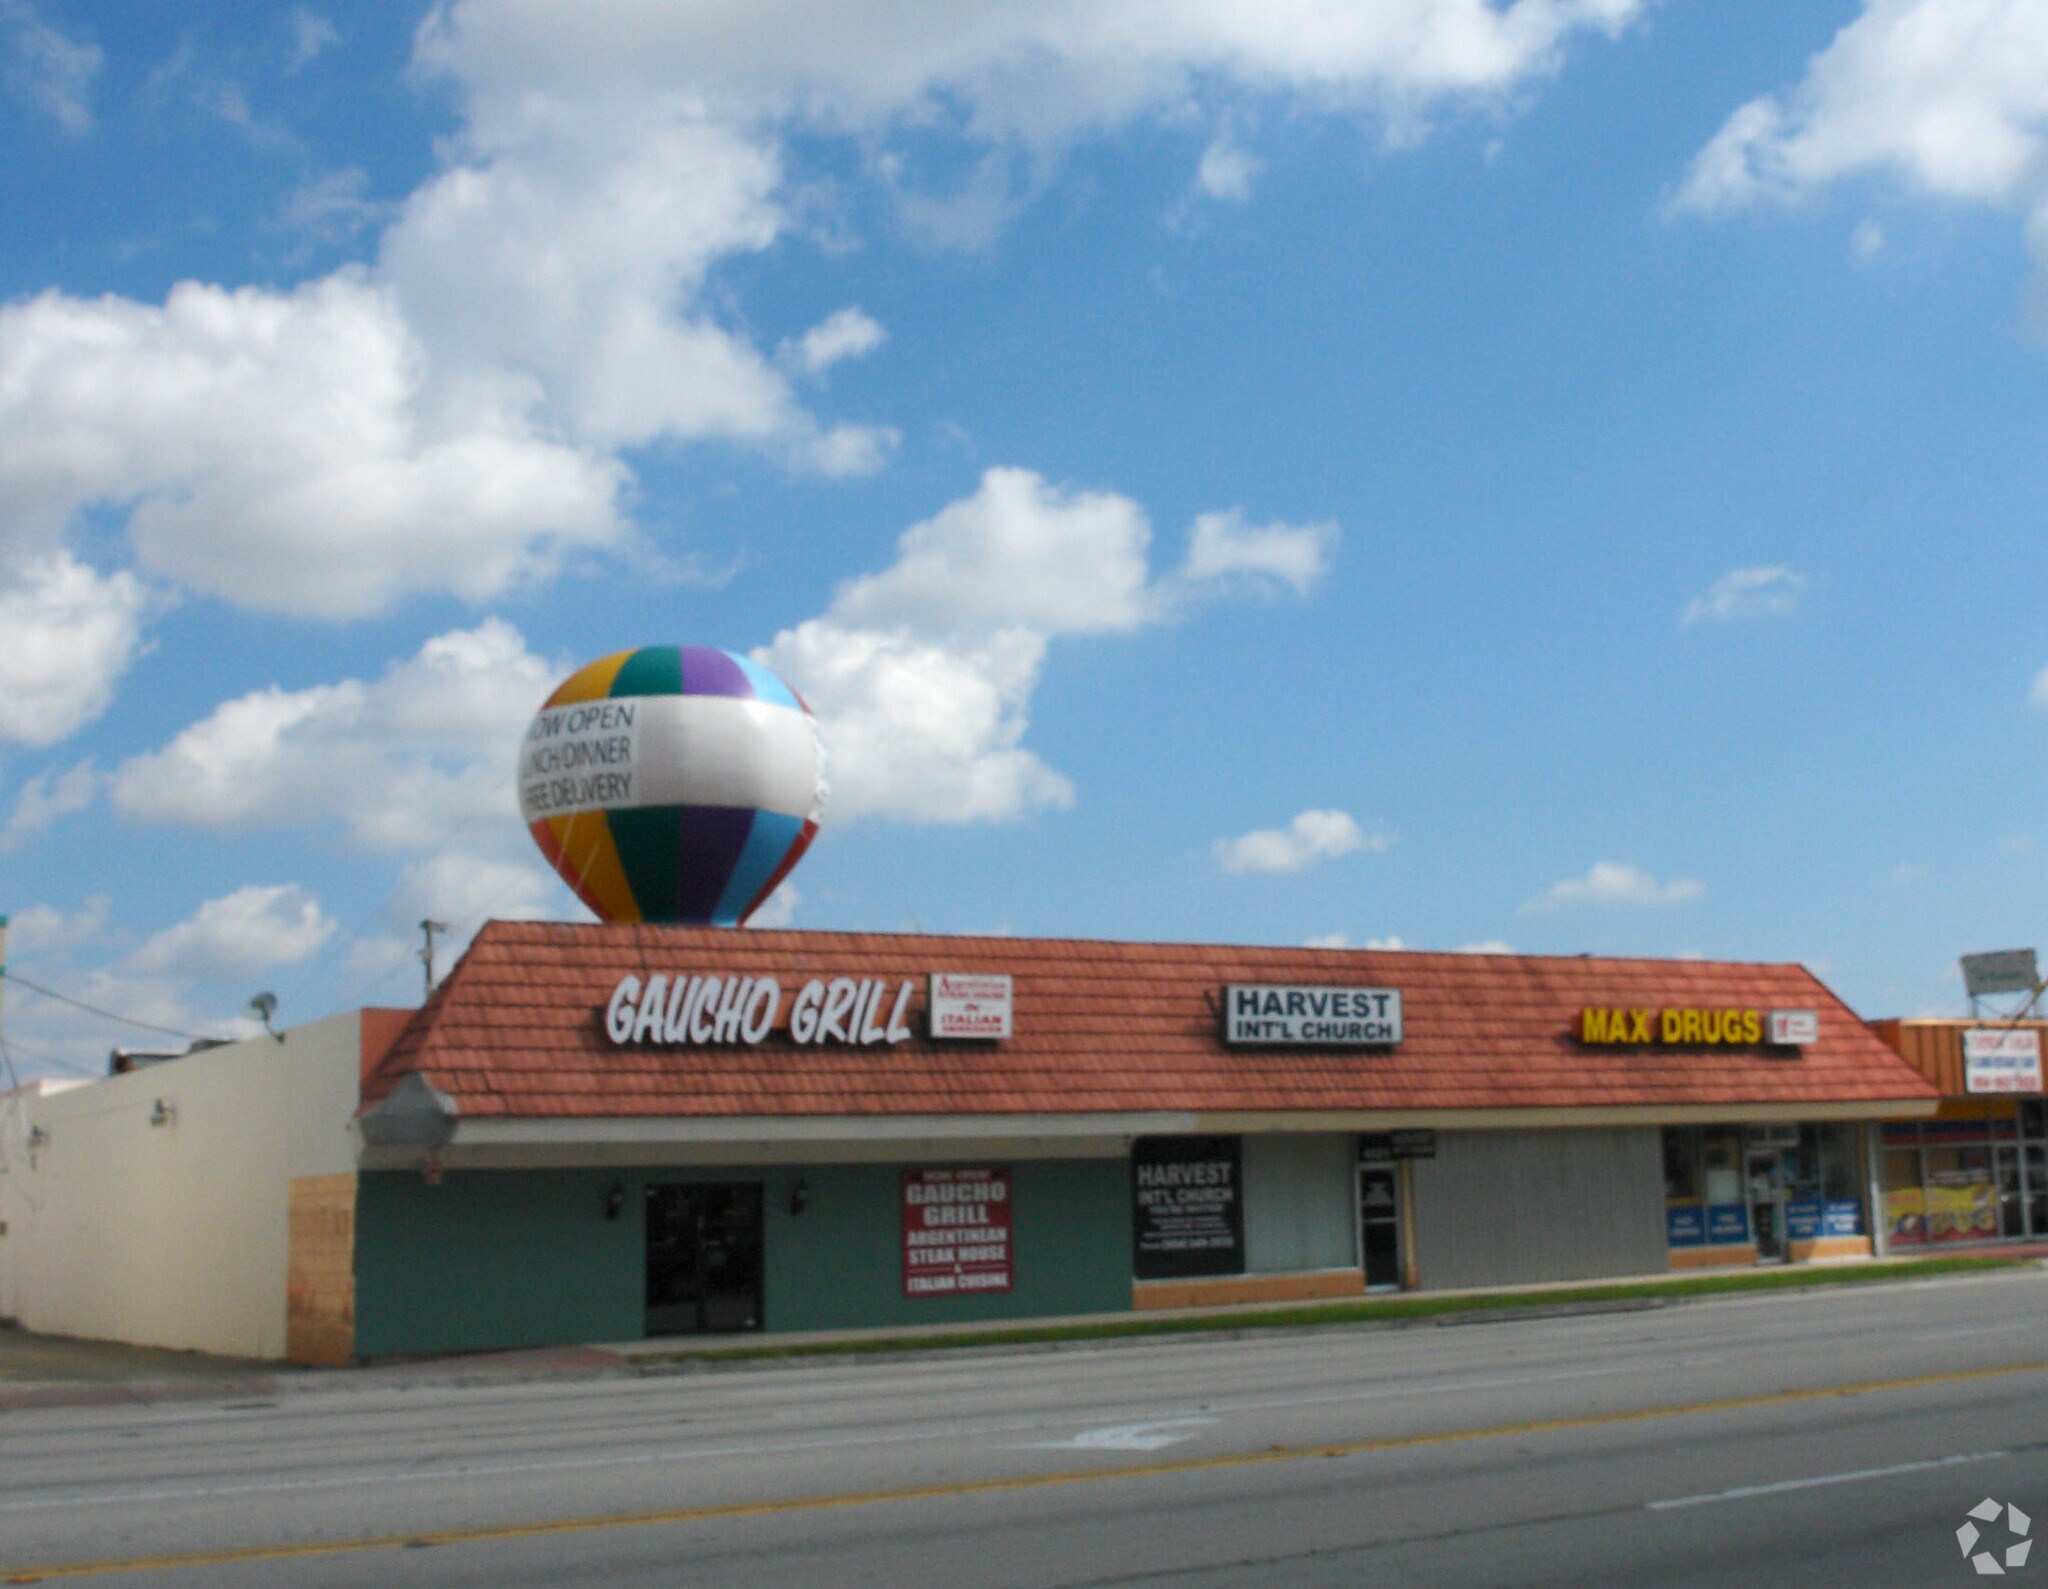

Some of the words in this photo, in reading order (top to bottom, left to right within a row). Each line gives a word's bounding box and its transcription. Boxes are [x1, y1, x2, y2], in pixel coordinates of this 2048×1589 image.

[528, 712, 566, 740] OW
[568, 704, 636, 733] OPEN
[550, 773, 632, 807] DELIVERY
[606, 973, 781, 1044] GAUCHO
[790, 977, 914, 1045] GRILL
[1237, 990, 1390, 1018] HARVEST
[1237, 1021, 1293, 1038] INT'L
[1301, 1022, 1392, 1039] CHURCH
[1582, 1007, 1650, 1044] MAX
[1662, 1007, 1762, 1044] DRUGS
[1137, 1162, 1232, 1186] HARVEST
[906, 1180, 1007, 1204] GAUCHO
[923, 1204, 990, 1226] GRILL
